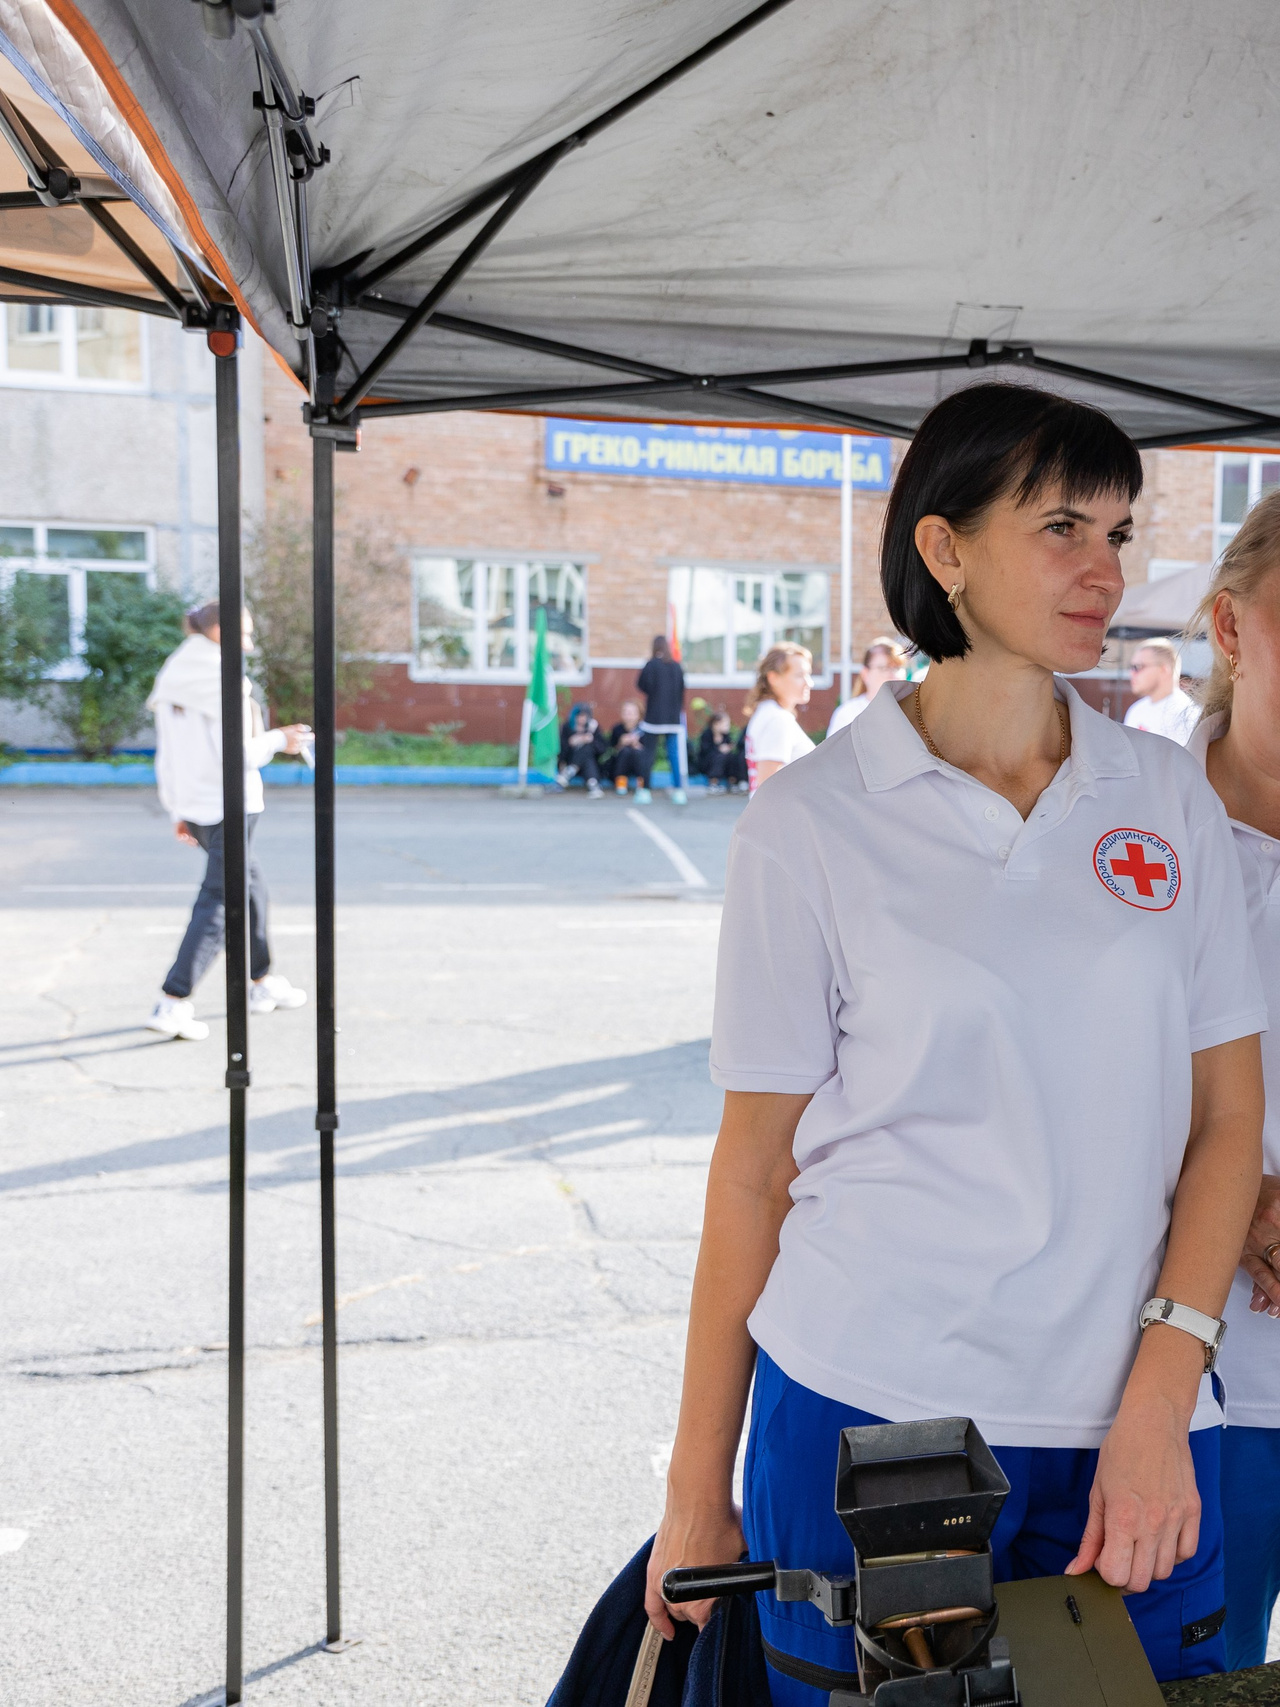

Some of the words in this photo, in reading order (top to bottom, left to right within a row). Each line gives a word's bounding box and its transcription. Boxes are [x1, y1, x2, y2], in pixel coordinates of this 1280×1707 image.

[553, 430, 778, 477] ГРЕКО-РИМСКАЯ
[1098, 831, 1168, 858] медицинская
[1097, 858, 1126, 897] скорая
[1165, 853, 1179, 899] помощь
